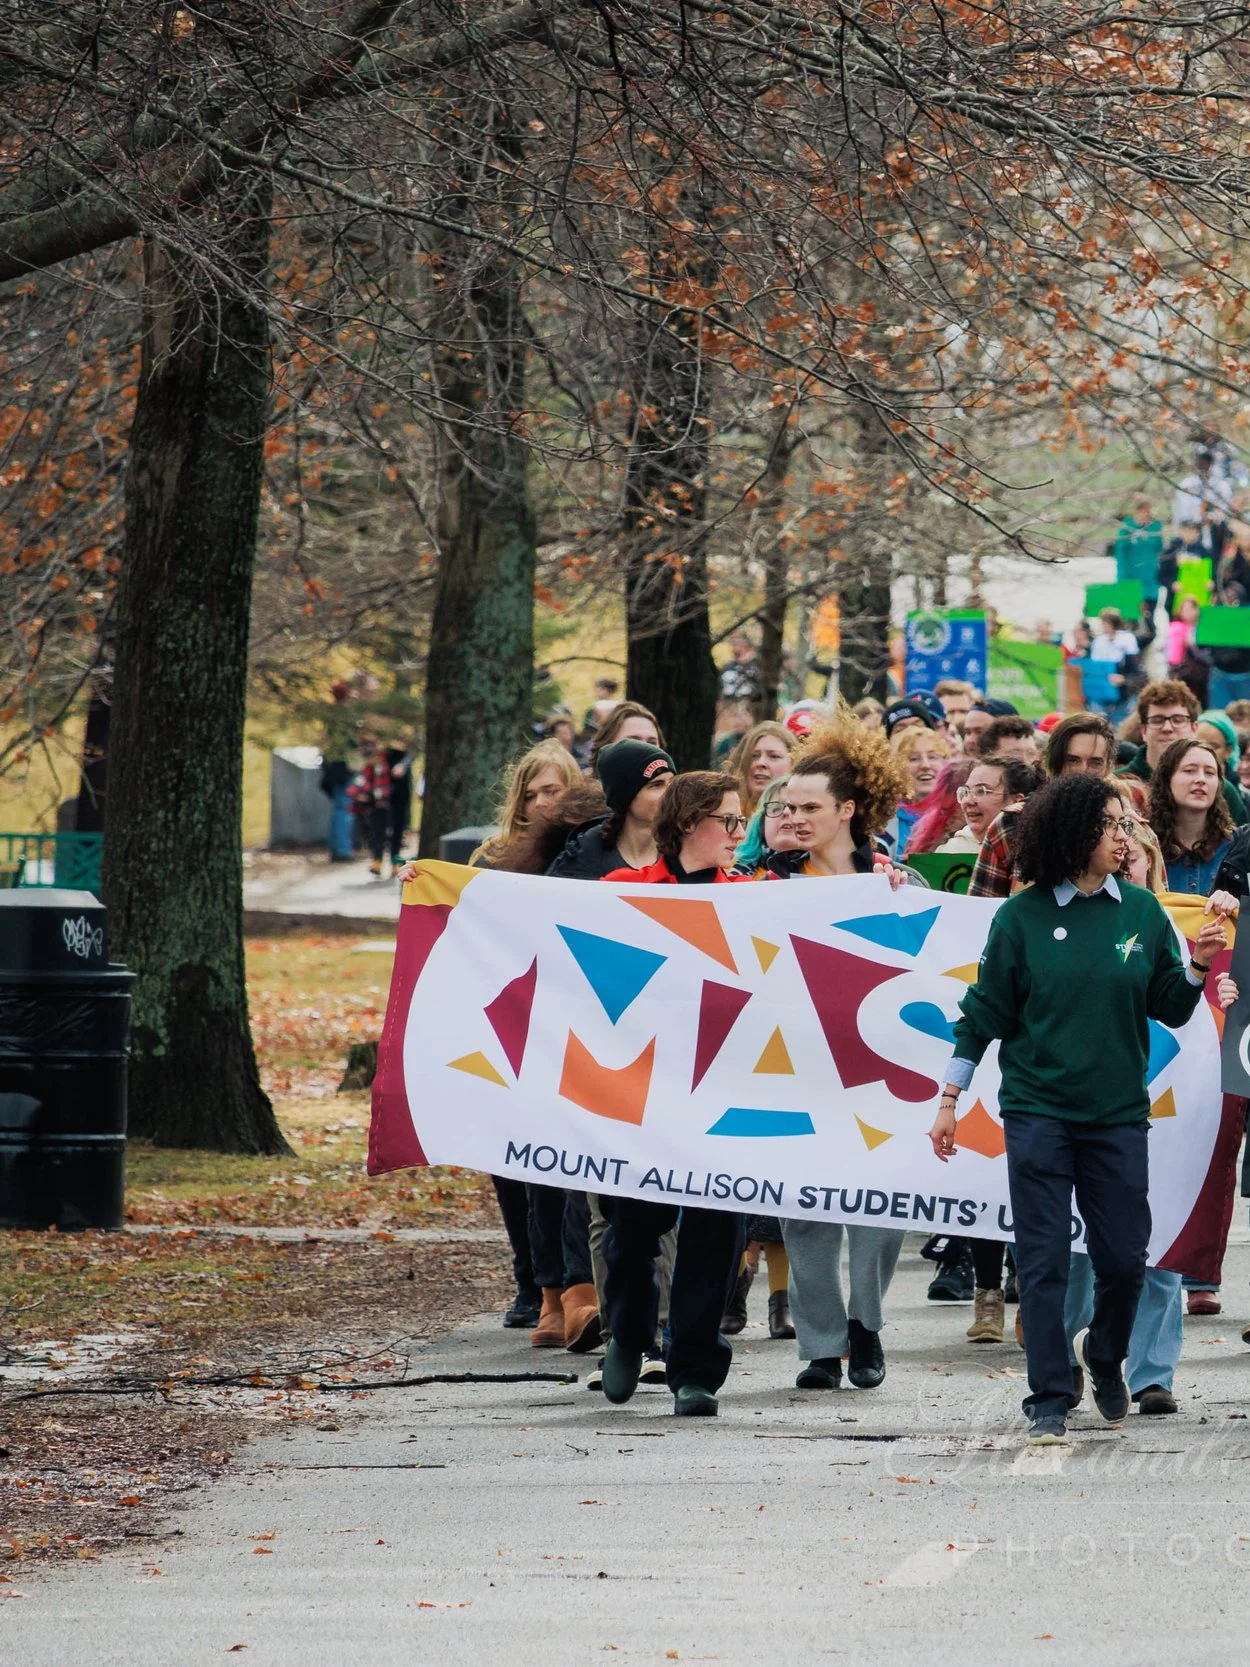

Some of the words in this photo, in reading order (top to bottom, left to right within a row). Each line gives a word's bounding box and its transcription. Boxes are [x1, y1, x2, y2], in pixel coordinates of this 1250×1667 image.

[504, 1140, 629, 1186] MOUNT
[638, 1166, 784, 1206] ALLISON
[797, 1185, 988, 1227] STUDENTS'
